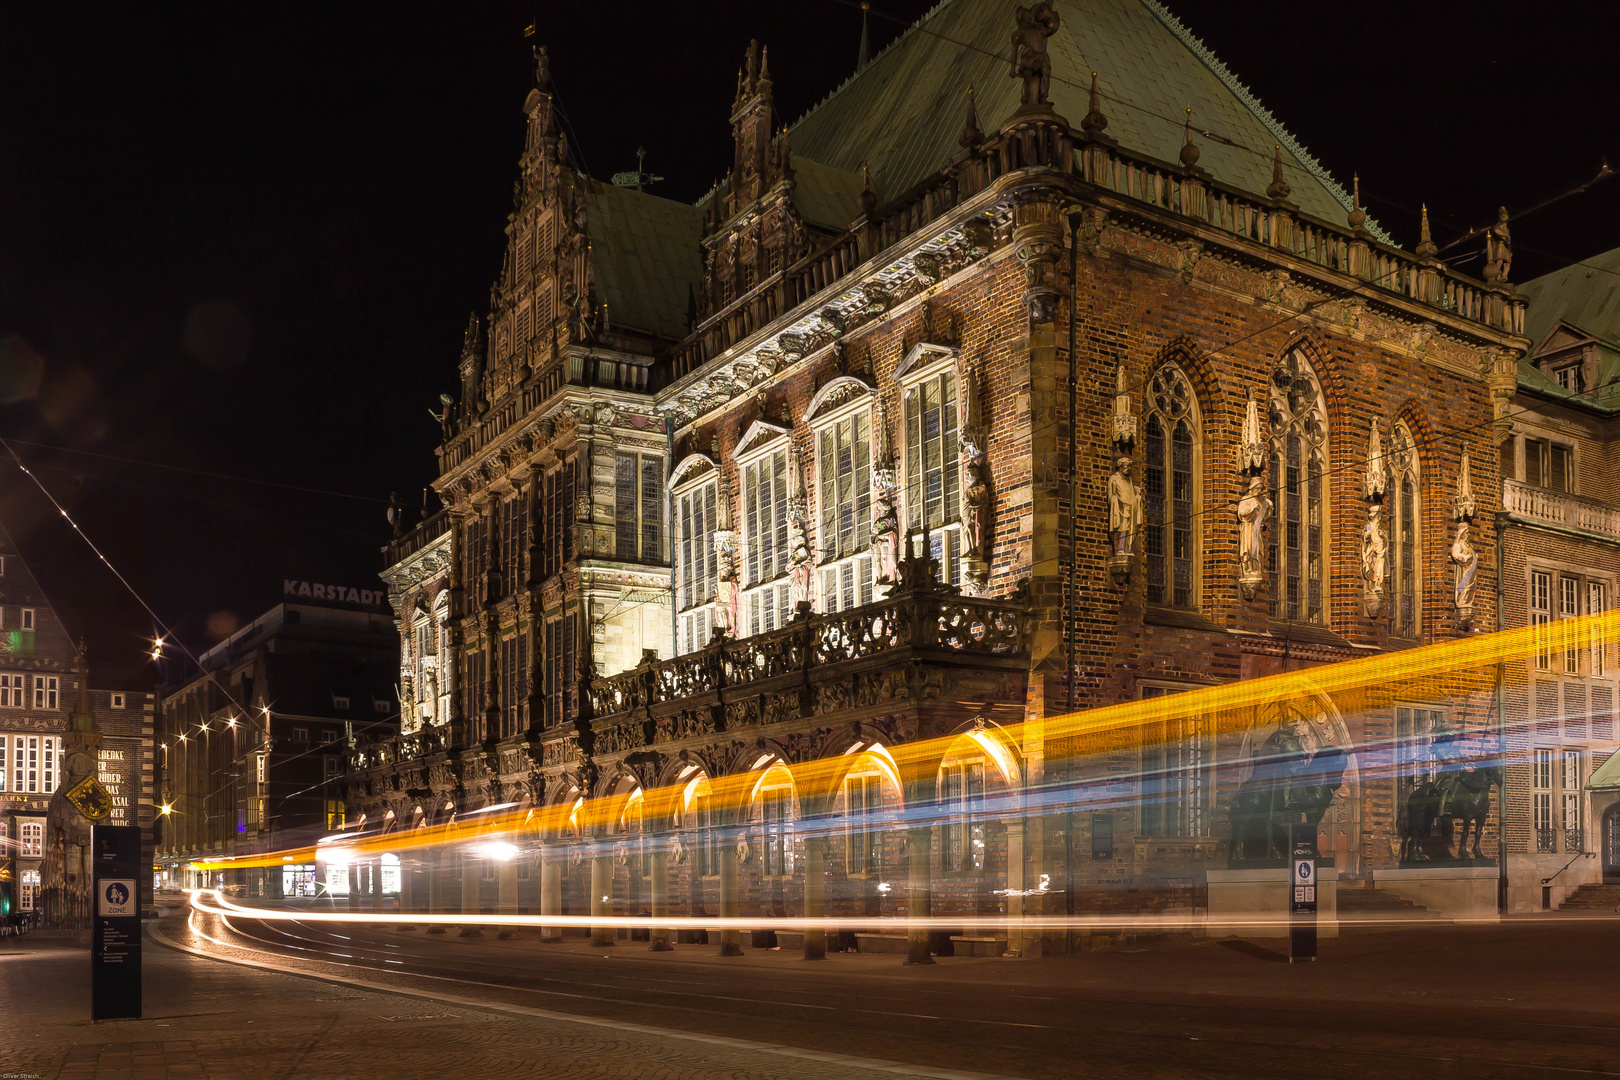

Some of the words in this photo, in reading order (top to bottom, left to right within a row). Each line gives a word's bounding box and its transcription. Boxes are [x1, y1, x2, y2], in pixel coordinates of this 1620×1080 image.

[283, 579, 384, 605] KARSTADT
[98, 749, 124, 760] EDENKE
[98, 761, 107, 771] ER
[98, 772, 125, 784] RÜDER,
[112, 796, 129, 807] KSAL
[110, 808, 125, 818] RER
[108, 906, 127, 914] ZONE
